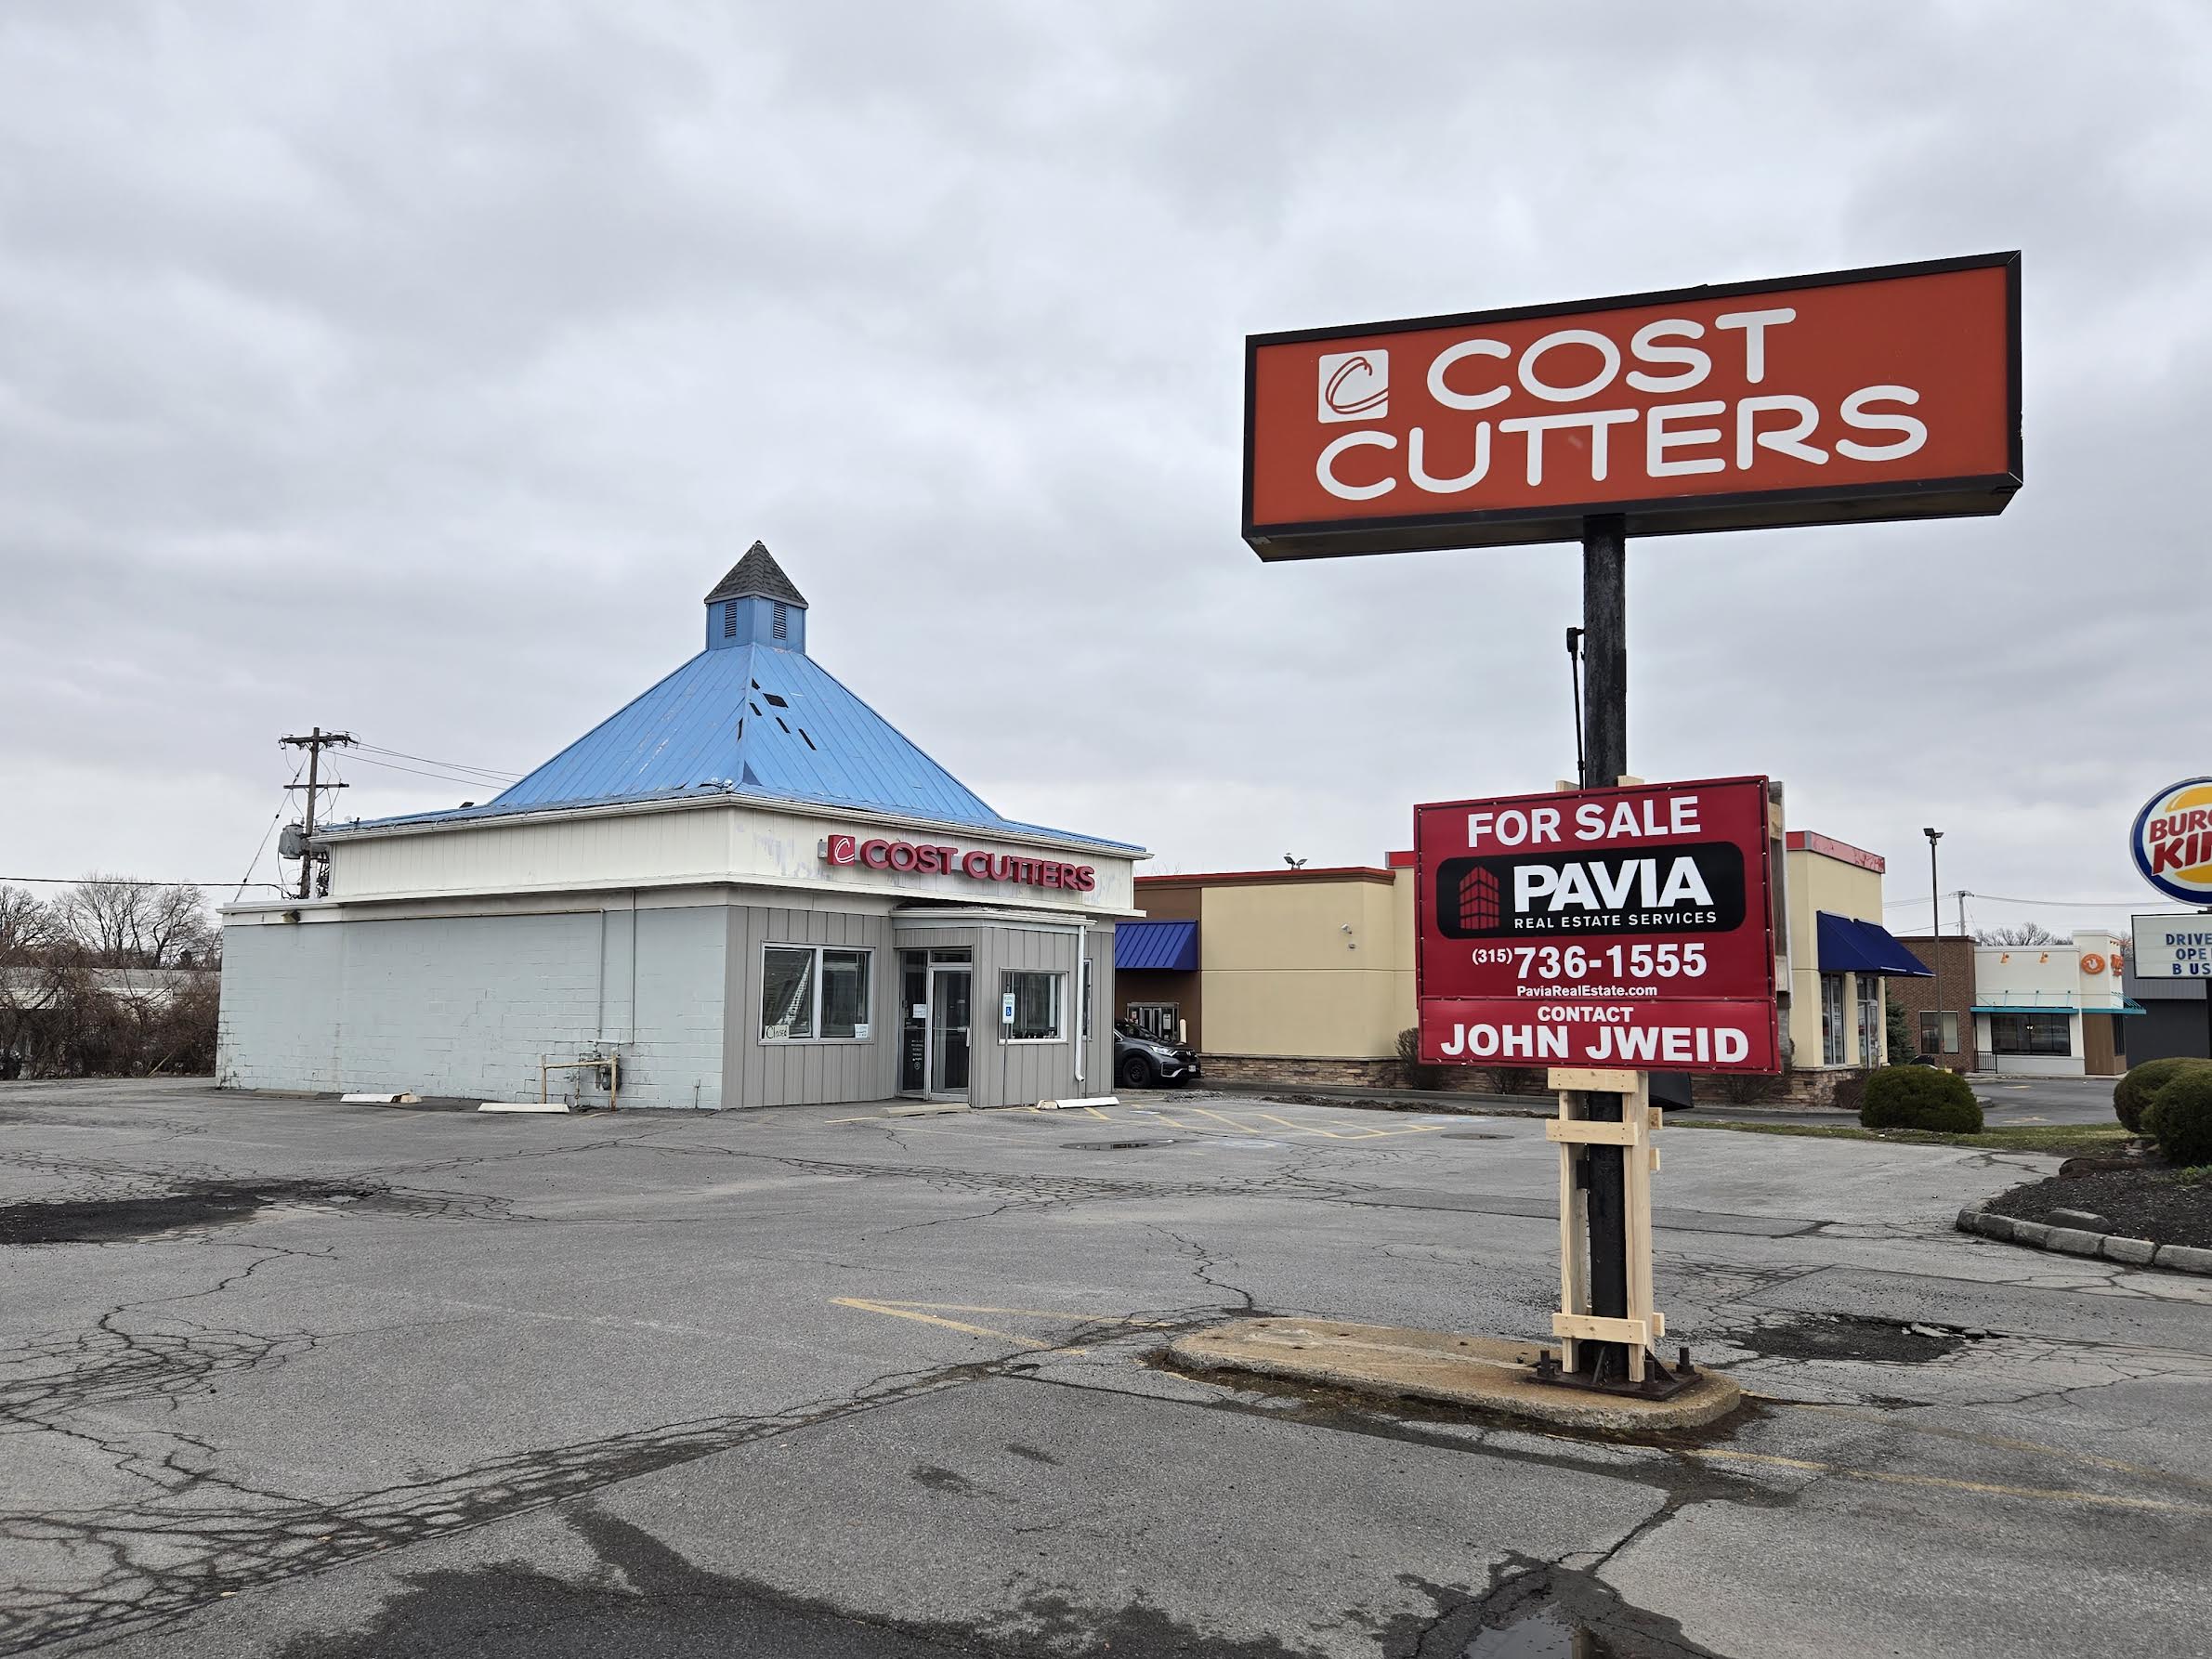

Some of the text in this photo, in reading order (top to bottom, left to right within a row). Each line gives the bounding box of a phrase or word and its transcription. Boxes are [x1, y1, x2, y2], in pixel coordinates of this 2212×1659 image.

[1427, 307, 1797, 411] COST
[1315, 385, 1928, 501] CUTTERS
[1467, 796, 1701, 848] FOR SALE
[2149, 810, 2212, 843] BUR
[860, 839, 1096, 892] COST CUTTERS
[1513, 856, 1714, 913] PAVIA
[1514, 911, 1717, 929] REAL ESTATE SERVICES
[1472, 942, 1708, 979] (315) 736-1555
[2175, 947, 2212, 960] OPE
[1516, 985, 1658, 998] PaviaRealEstate.com
[1538, 1006, 1634, 1023] CONTACT
[1440, 1024, 1749, 1063] JOHN JWEID
